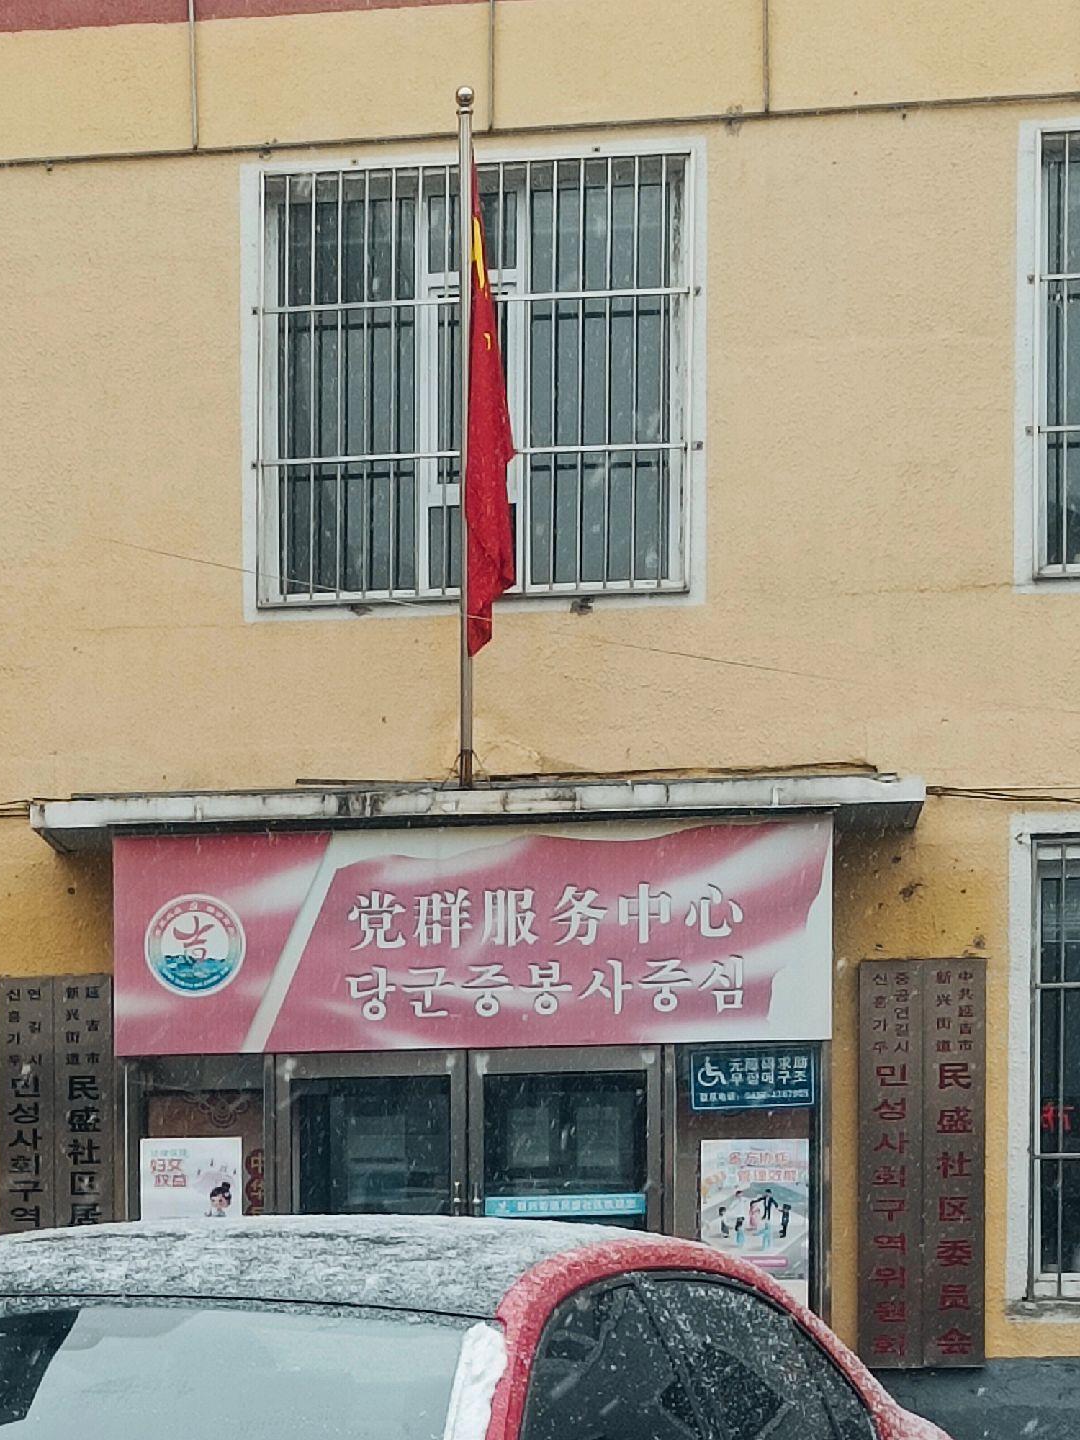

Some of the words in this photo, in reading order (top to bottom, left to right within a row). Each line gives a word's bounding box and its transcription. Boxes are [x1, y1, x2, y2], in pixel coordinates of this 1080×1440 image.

[347, 882, 744, 951] 党群服务中心
[345, 954, 745, 1021] 당군중봉사중심
[957, 970, 974, 1051] 中共延吉市
[872, 1063, 908, 1357] 민성사회구역위원회
[936, 1062, 973, 1356] 民盛社区委员会
